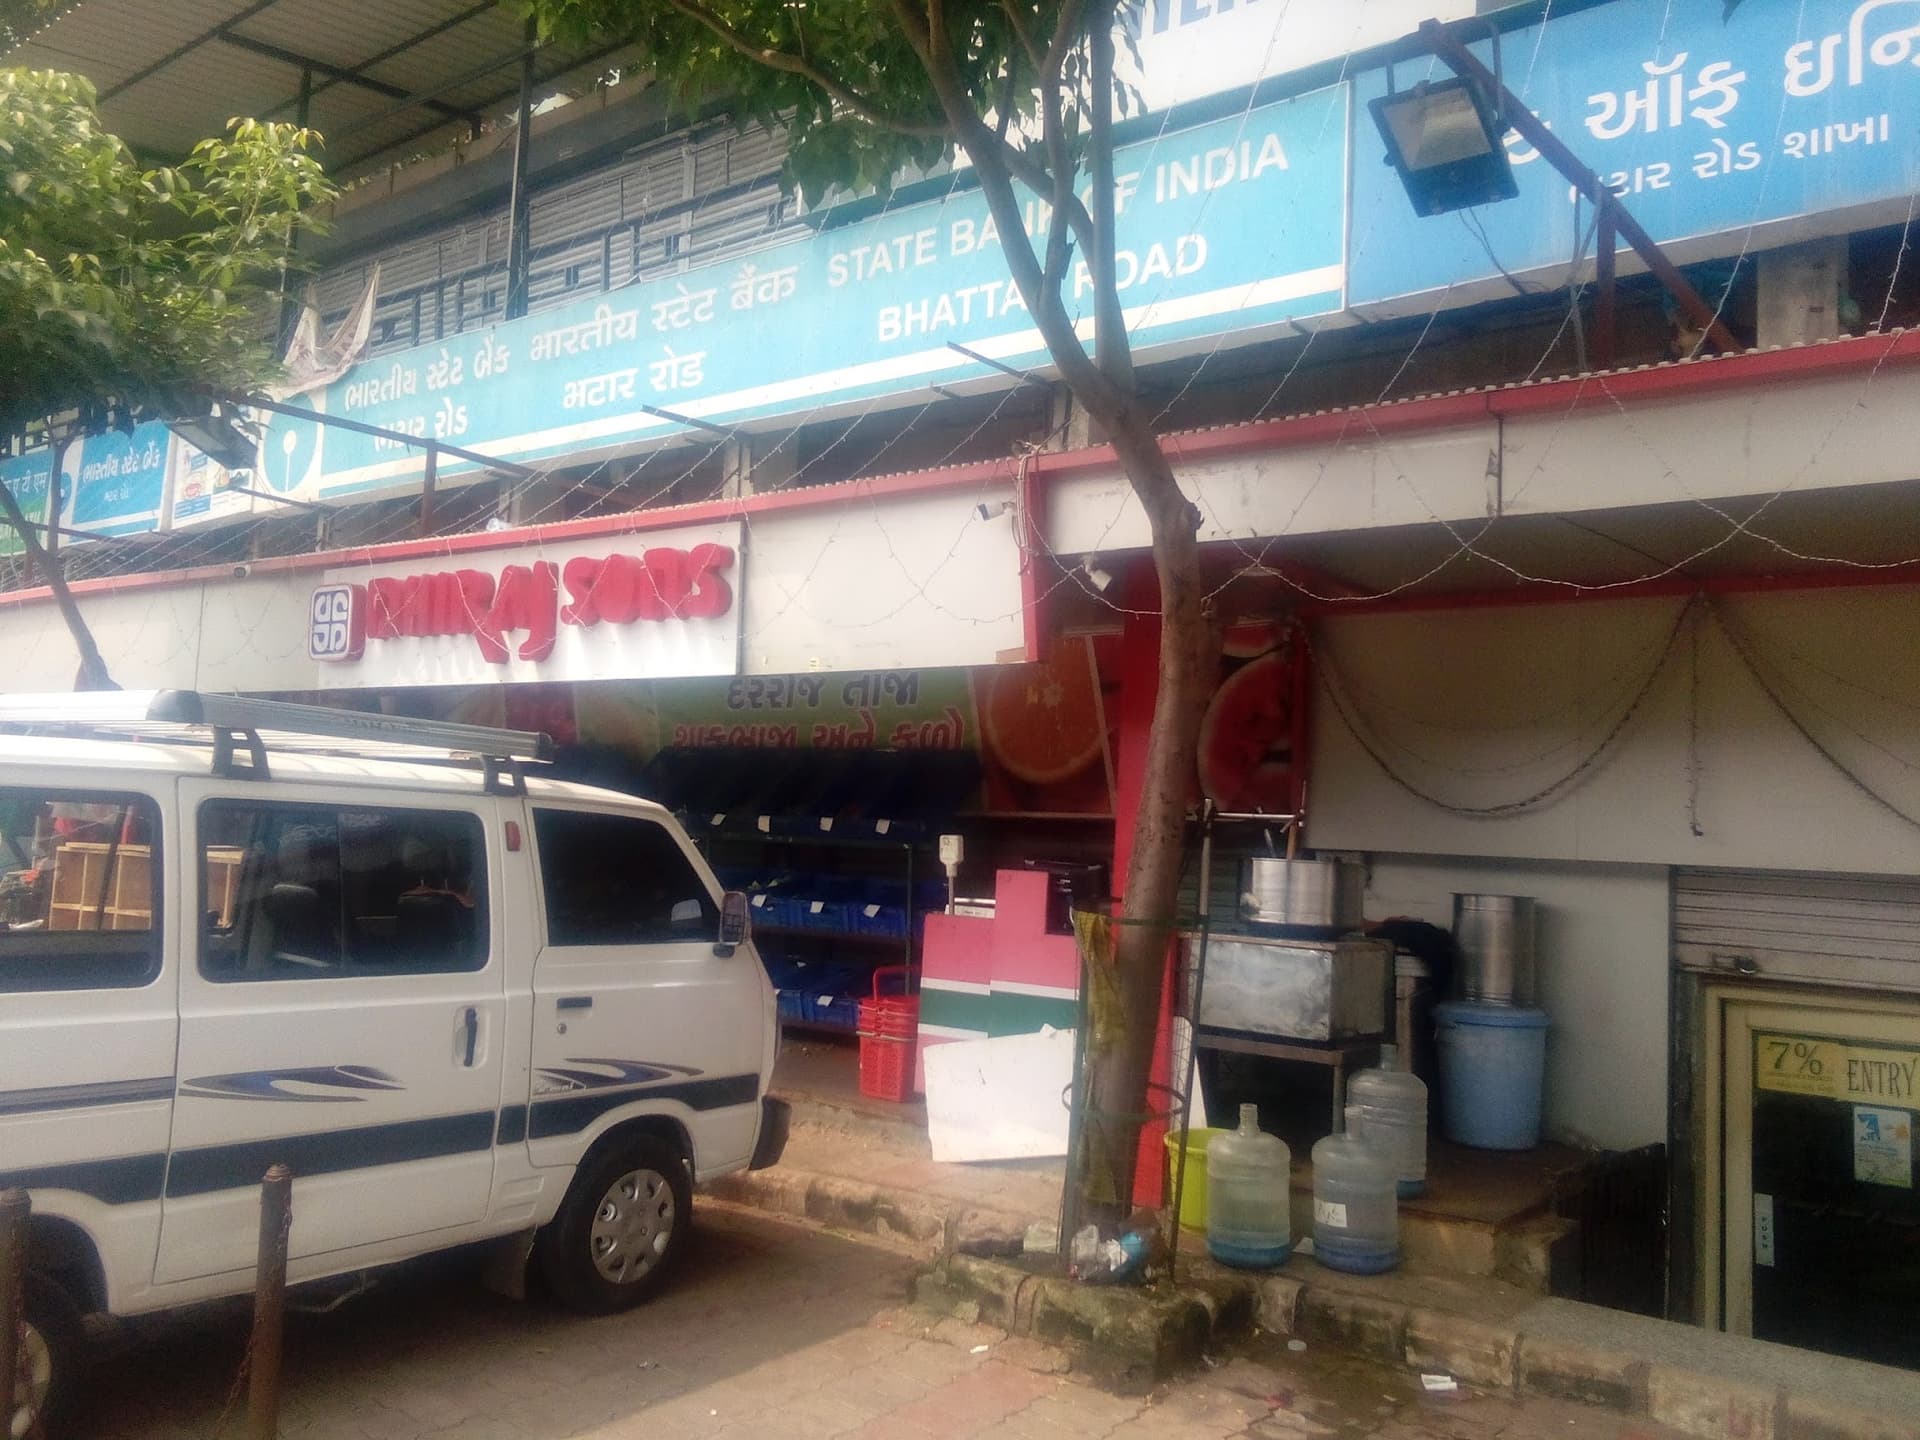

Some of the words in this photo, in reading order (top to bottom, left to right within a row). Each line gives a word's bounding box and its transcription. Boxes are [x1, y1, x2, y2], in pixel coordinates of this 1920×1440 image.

[1569, 161, 1672, 205] ટાર
[1693, 139, 1761, 179] રોડ
[1784, 114, 1888, 158] શાખા
[827, 228, 937, 288] STATE
[1156, 133, 1289, 203] INDIA
[530, 303, 640, 364] भारतीय
[652, 282, 718, 331] स्टेट
[731, 262, 798, 310] बैंक
[878, 277, 1029, 342] BHATTA
[1074, 234, 1208, 299] ROAD
[344, 362, 417, 412] ભારતીય
[426, 347, 464, 391] સ્ટેટ
[563, 367, 639, 408] भटार
[650, 345, 706, 391] रोड
[434, 396, 468, 438] રોડ
[1767, 1041, 1823, 1075] 7%
[1847, 1057, 1917, 1099] ENTRY
